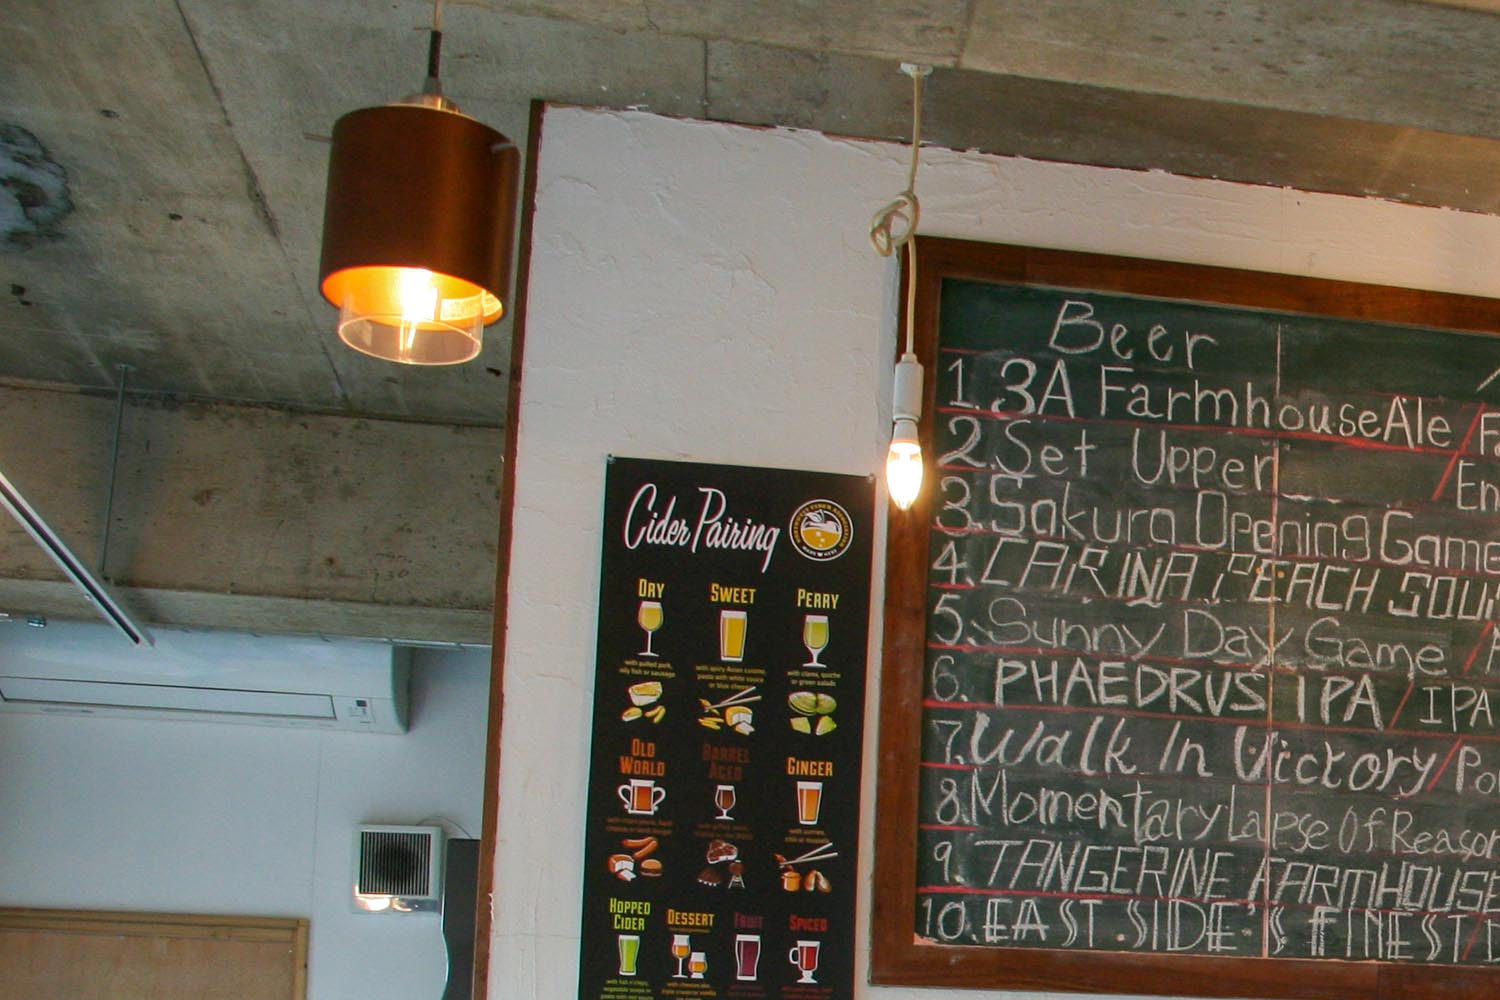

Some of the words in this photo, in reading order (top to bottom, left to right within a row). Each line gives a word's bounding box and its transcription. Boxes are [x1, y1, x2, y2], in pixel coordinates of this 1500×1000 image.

[1048, 300, 1218, 369] Beer
[993, 359, 1075, 420] 3A
[996, 419, 1096, 477] Set
[1133, 428, 1275, 490] Upper
[623, 482, 692, 552] Cider
[691, 486, 780, 574] Pairing
[990, 474, 1176, 546] Sakura
[1196, 491, 1370, 562] Opening
[638, 578, 665, 599] DRY
[710, 584, 757, 605] SWEET
[797, 589, 839, 611] PERRY
[975, 598, 1165, 652] Sunny
[1185, 610, 1293, 670] Day
[1306, 617, 1447, 677] Game
[996, 657, 1267, 716] PHAEDRUS
[1298, 674, 1383, 731] IPA
[1420, 686, 1493, 731] IPA
[620, 754, 666, 777] WORLD
[631, 738, 656, 759] OLD
[787, 757, 833, 776] GINGER
[970, 711, 1138, 775] Walk
[1161, 722, 1213, 778] In
[1235, 724, 1438, 799] Victory
[970, 768, 1227, 847] Momentary
[1229, 784, 1329, 851] Lapse
[974, 840, 1234, 900] TANGERINE
[610, 898, 651, 915] HOPPED
[614, 914, 645, 931] CIDER
[667, 909, 715, 927] DESSERT
[985, 899, 1104, 948] EAST
[1310, 905, 1470, 963] FINEST
